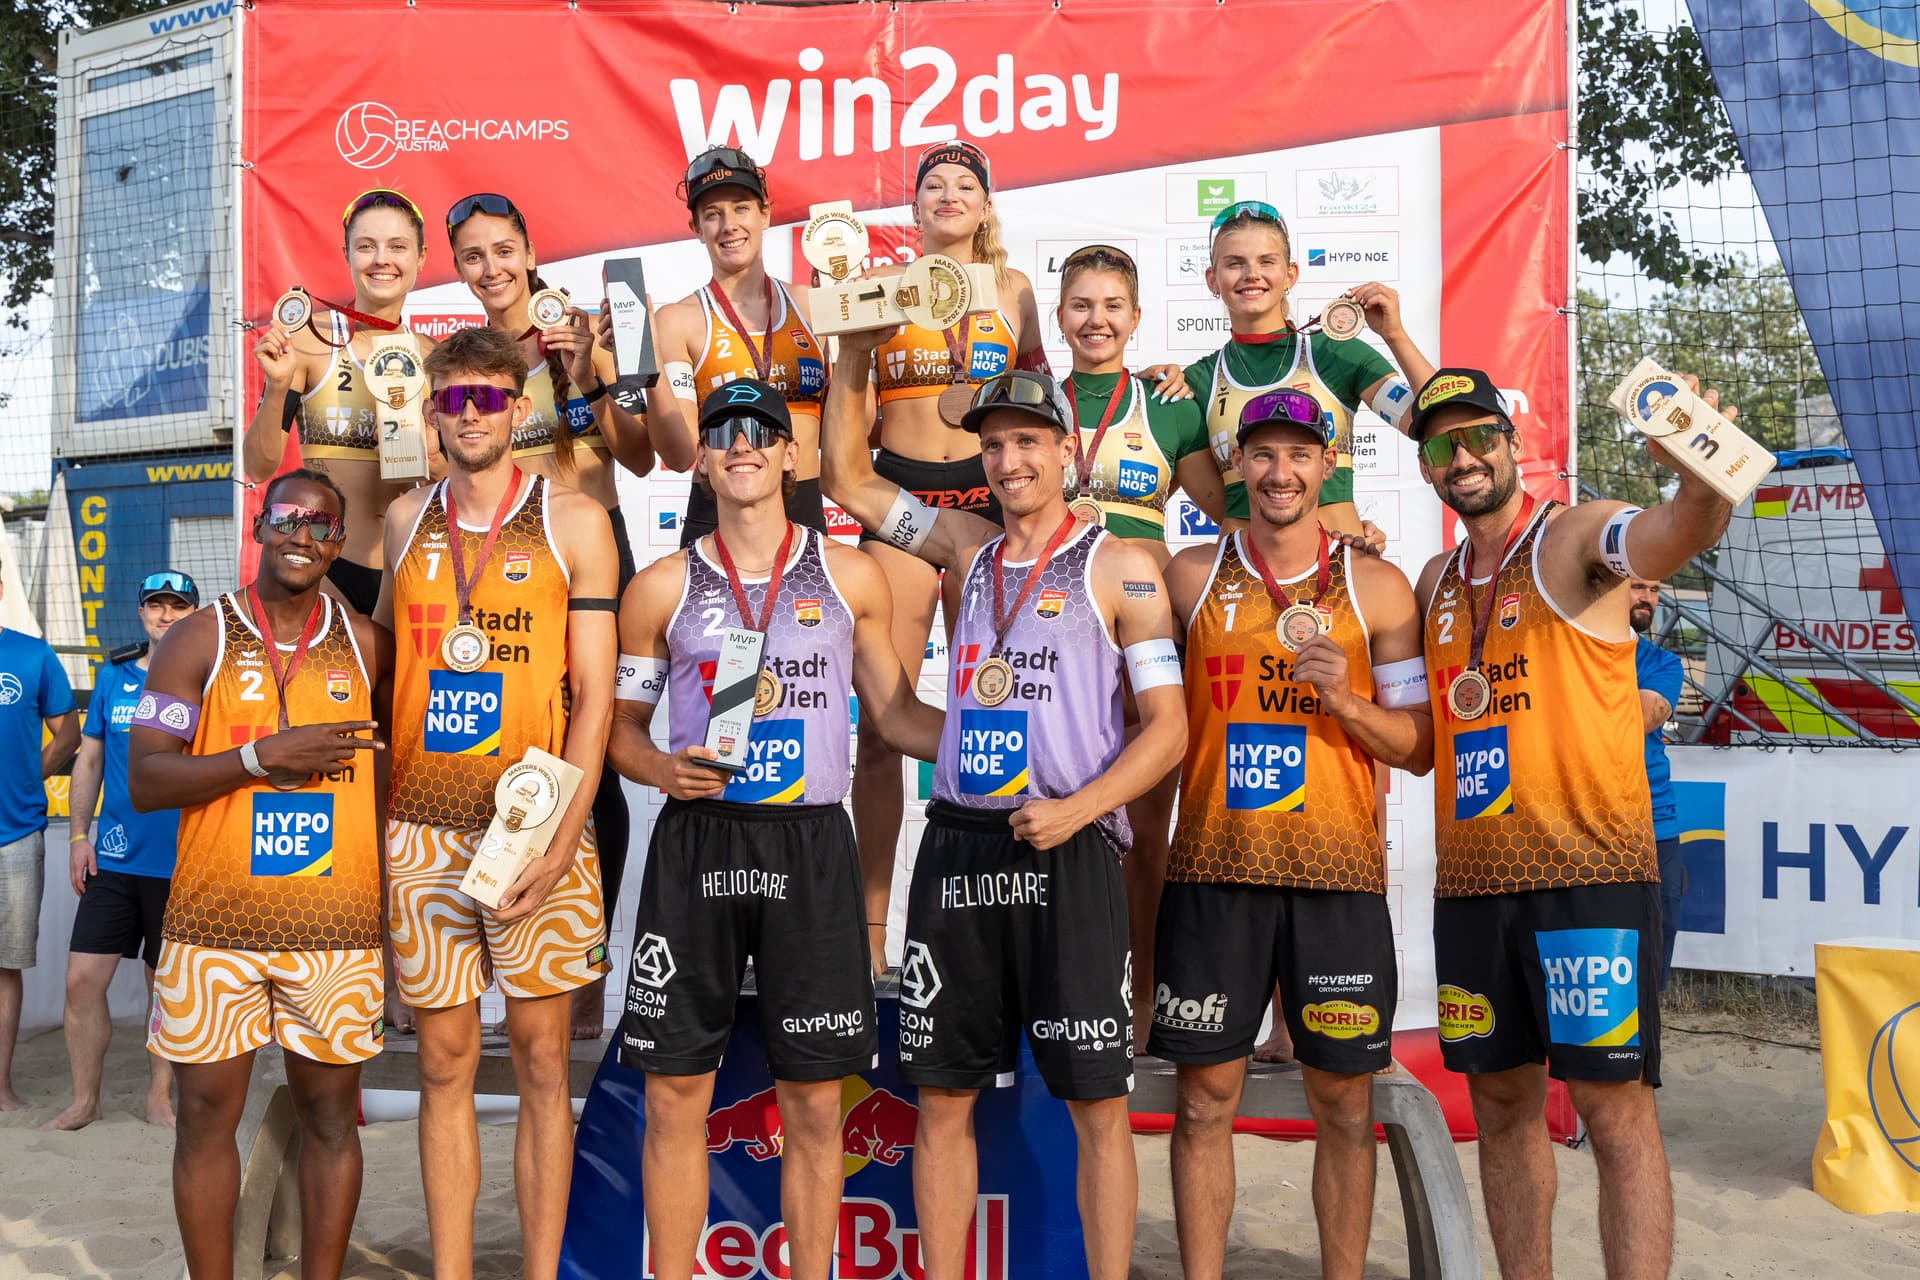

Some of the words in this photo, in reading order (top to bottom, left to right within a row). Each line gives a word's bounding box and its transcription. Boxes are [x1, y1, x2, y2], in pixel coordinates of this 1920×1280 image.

[669, 45, 1119, 168] win2day
[395, 119, 569, 142] BEACHCAMPS
[395, 140, 449, 152] AUSTRIA
[702, 169, 732, 184] smile
[1329, 252, 1362, 262] HYPO
[1365, 252, 1389, 261] NOE
[858, 284, 886, 301] 1
[934, 258, 966, 287] MASTERS
[958, 286, 967, 311] WIEN
[614, 301, 636, 310] MVP
[840, 293, 849, 320] Men
[716, 339, 732, 359] 2
[973, 351, 1007, 364] HYPO
[743, 364, 787, 379] Stdt
[800, 365, 824, 379] HYPO
[973, 361, 997, 372] NOE
[338, 371, 352, 392] 2
[801, 376, 820, 388] NOE
[567, 407, 592, 418] YPO
[1219, 398, 1226, 417] 1
[383, 420, 400, 441] 2
[1353, 433, 1377, 443] adt
[1690, 432, 1720, 461] 3
[384, 455, 417, 464] Women
[1725, 453, 1750, 478] Men
[1119, 480, 1148, 493] NOE
[1120, 468, 1157, 485] HYPO
[890, 511, 914, 544] HYPO
[900, 524, 919, 549] NOE
[423, 541, 447, 549] erima
[426, 553, 440, 580] 1
[1124, 583, 1154, 591] POLIZEI
[701, 607, 727, 637] 2
[1223, 603, 1237, 632] 1
[1438, 612, 1454, 645] 2
[729, 632, 757, 646] MVP
[1775, 622, 1917, 651] BUNDES
[488, 635, 530, 663] ien
[1003, 646, 1059, 673] tadt
[1259, 654, 1297, 682] Sta
[240, 670, 265, 700] 2
[1013, 673, 1053, 702] ien
[111, 706, 136, 715] HYP
[429, 690, 499, 713] HYPO
[1492, 687, 1532, 716] ien
[427, 712, 480, 736] NOE
[751, 739, 801, 761] YPO
[960, 730, 1023, 752] HYPO
[960, 753, 1005, 776] NOE
[1229, 743, 1302, 767] HYPO
[1454, 747, 1506, 777] HYPO
[1229, 767, 1281, 790] NOE
[1456, 773, 1490, 800] NOE
[255, 812, 330, 833] HYPO
[255, 835, 310, 856] NOE
[480, 832, 505, 862] 2
[1762, 821, 1920, 908] HY
[475, 869, 498, 889] Men
[702, 868, 790, 900] HELIOCARE
[940, 871, 1049, 910] HELIOCARE
[1308, 974, 1374, 986] MOVEMED
[1543, 955, 1633, 985] HYPO
[628, 984, 668, 1008] REON
[1154, 982, 1228, 1023] Profi
[1548, 987, 1609, 1018] NOE
[626, 1000, 666, 1020] GROUP
[782, 1009, 863, 1034] GLYPUNO
[901, 1008, 934, 1032] EON
[1308, 1010, 1373, 1025] NORIS
[1106, 1039, 1121, 1049] med
